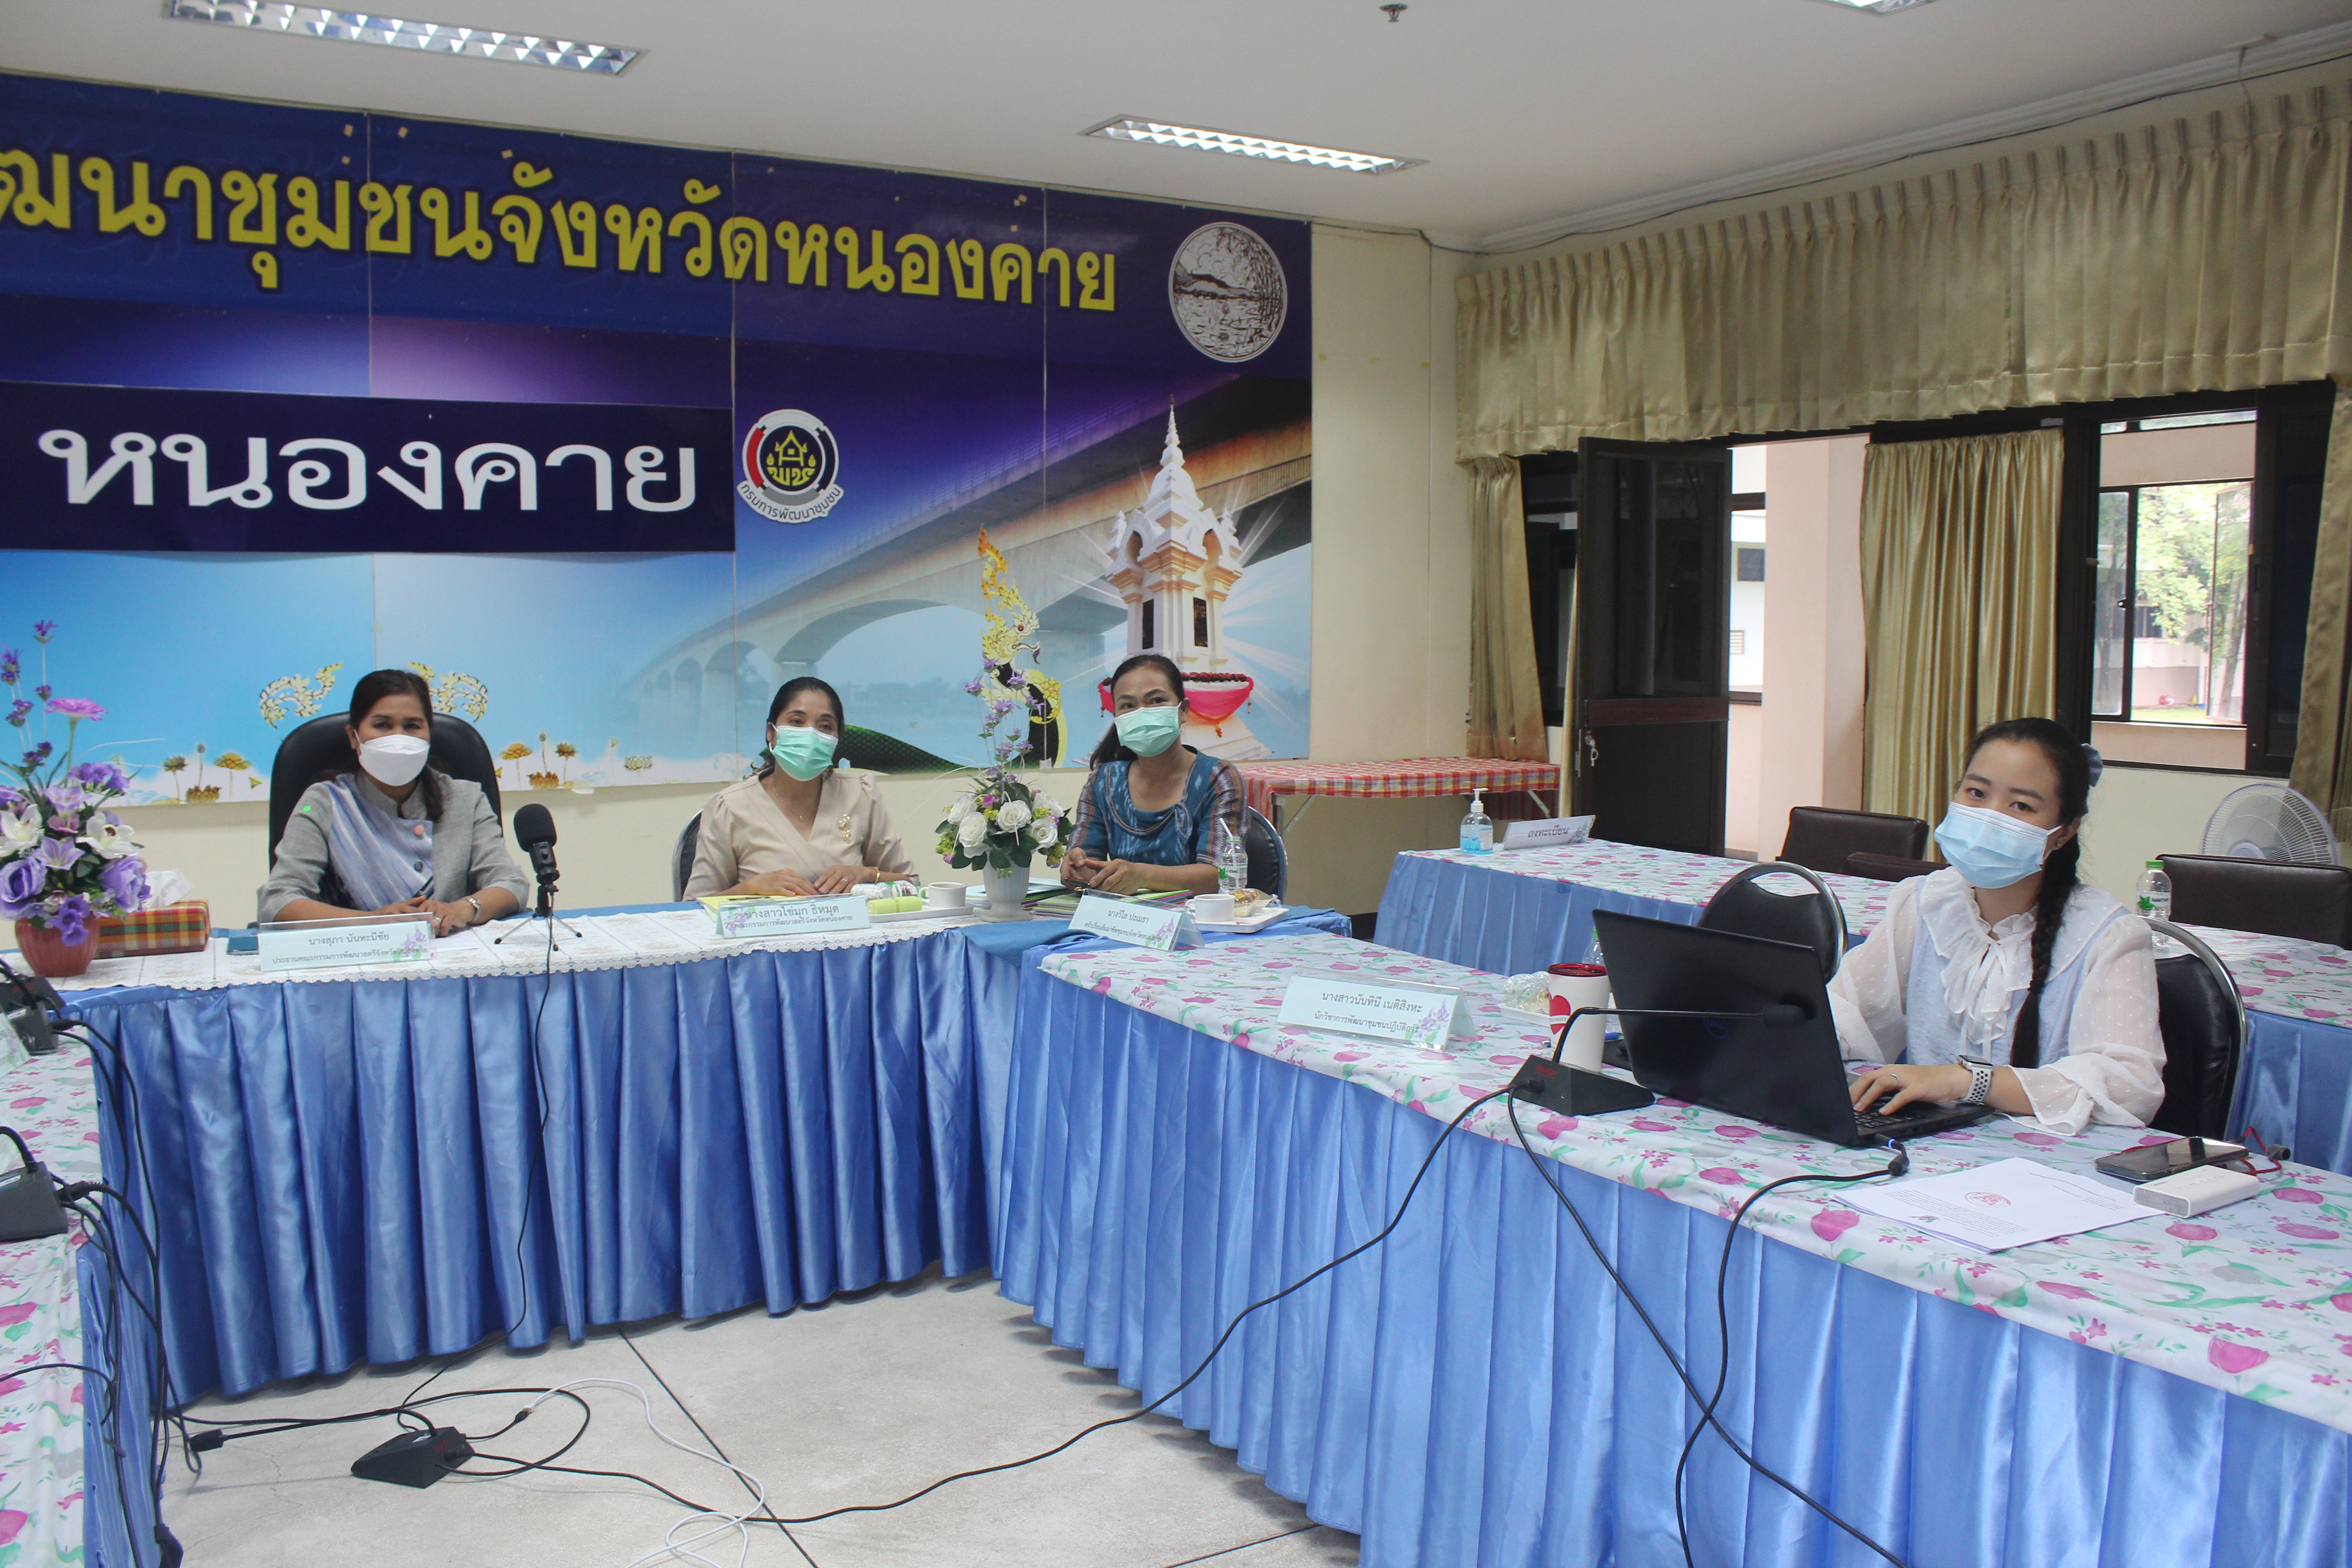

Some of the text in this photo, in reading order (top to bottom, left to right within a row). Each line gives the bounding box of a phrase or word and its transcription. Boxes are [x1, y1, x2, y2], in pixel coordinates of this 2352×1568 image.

[38, 429, 696, 512] หนองคาย
[740, 484, 841, 520] กรมการพัฒนาชุมชน
[309, 935, 343, 946] นางสุภา
[1322, 993, 1423, 1013] นางสาวนันทินี เนติสิงหะ
[1314, 1011, 1419, 1033] นักวิชาการพัฒนาชุมชนปฏิบัติการ
